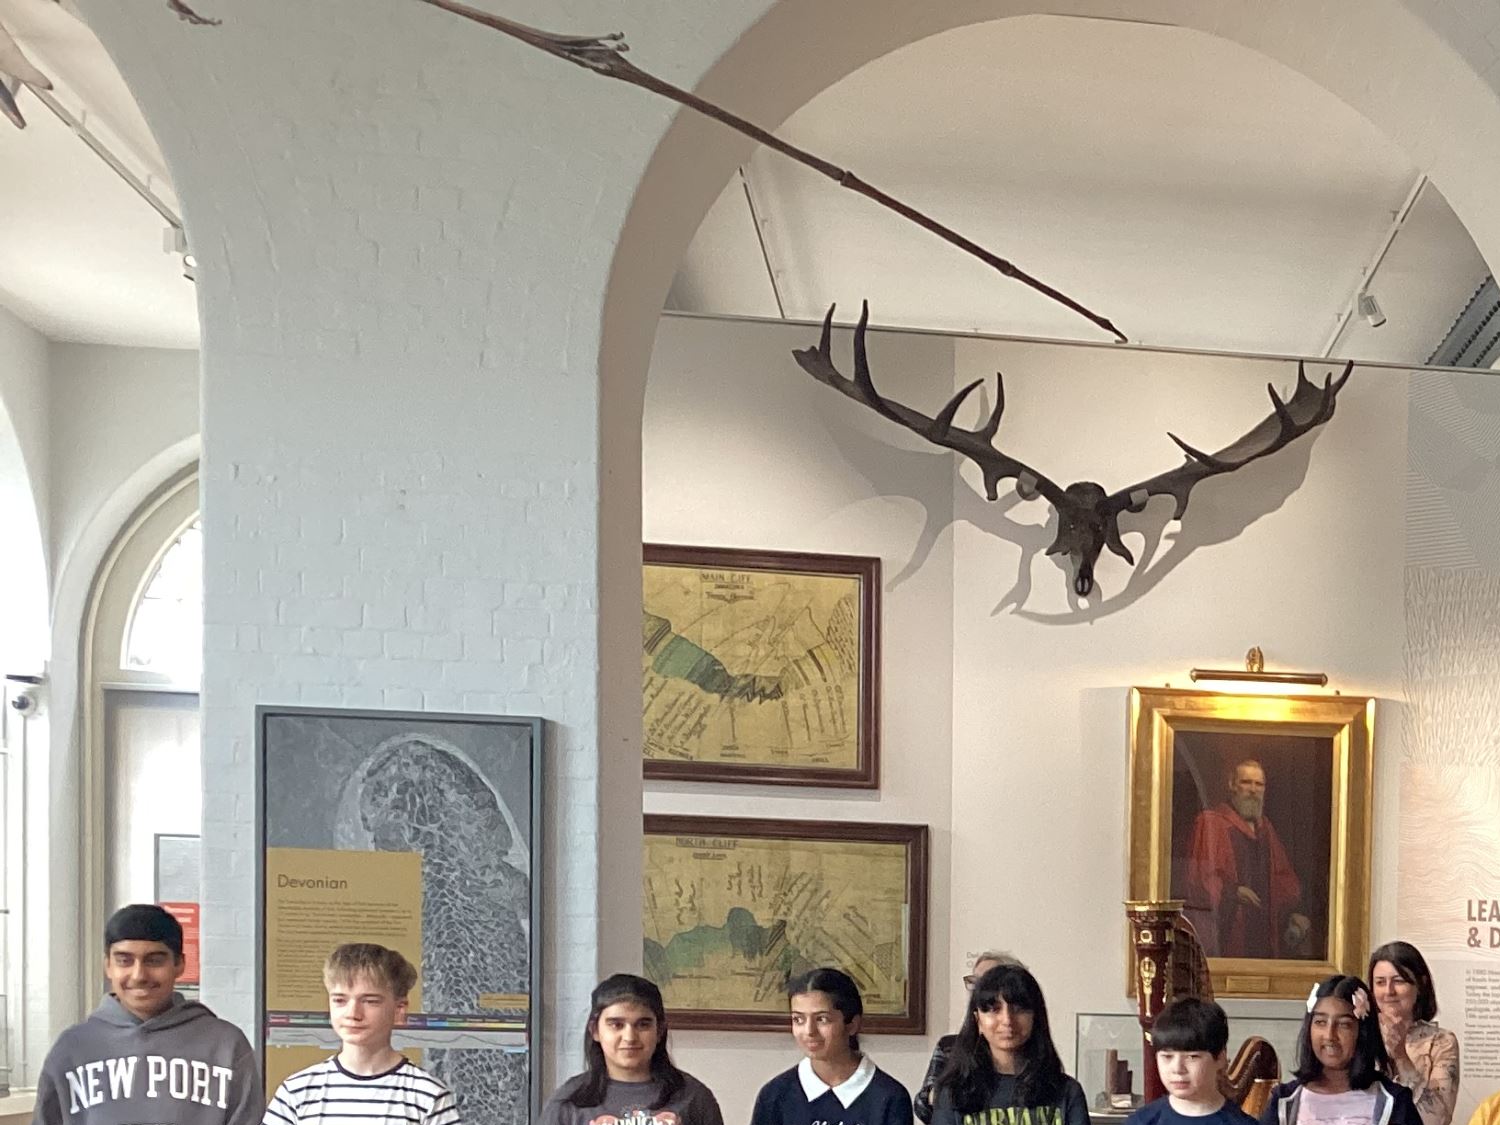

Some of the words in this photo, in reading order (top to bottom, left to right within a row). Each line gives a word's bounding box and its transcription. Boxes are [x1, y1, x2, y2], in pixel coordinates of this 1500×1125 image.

[277, 873, 348, 889] Devonian
[1467, 926, 1482, 948] &
[65, 1056, 138, 1114] NEW
[146, 1055, 233, 1109] PORT
